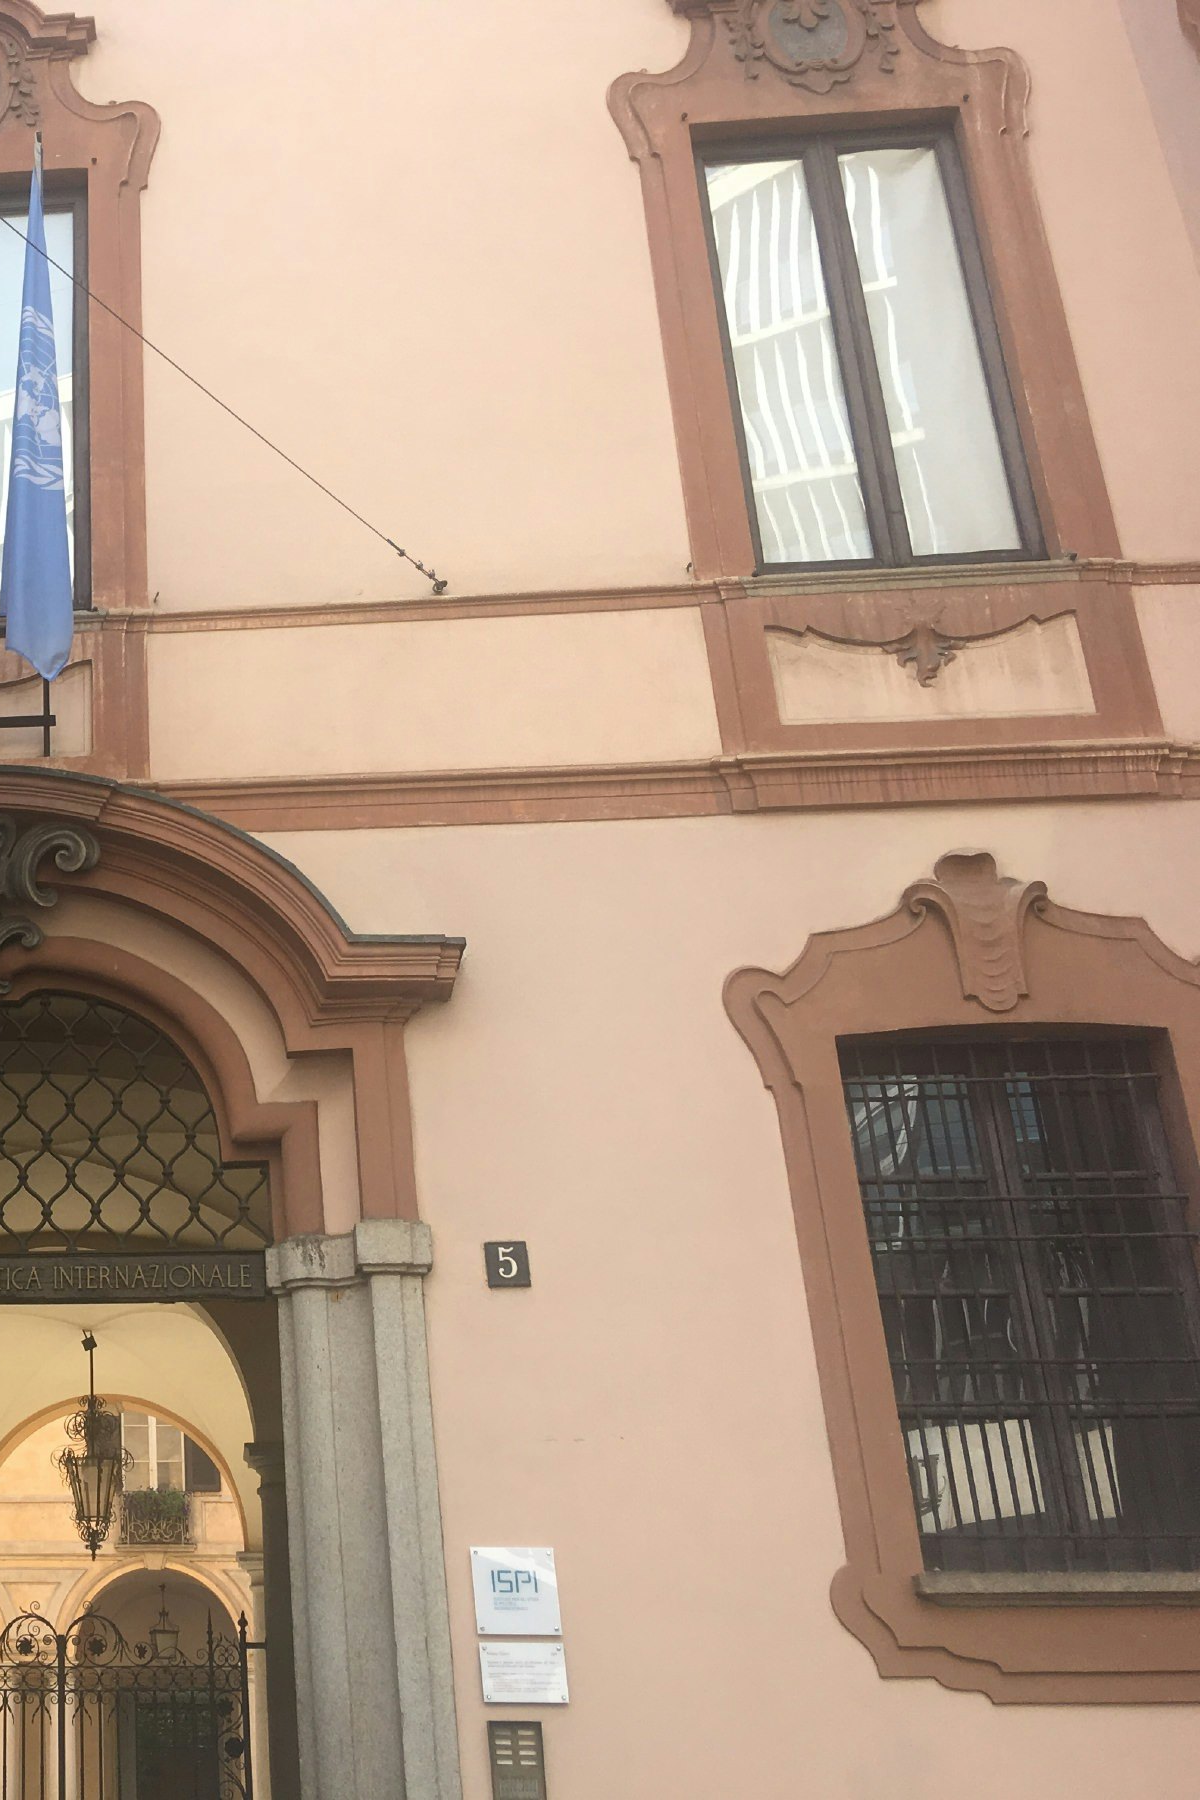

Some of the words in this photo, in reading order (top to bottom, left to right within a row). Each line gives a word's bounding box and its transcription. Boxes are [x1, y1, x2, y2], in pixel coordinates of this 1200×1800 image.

[498, 1246, 518, 1278] 5
[53, 1264, 252, 1289] INTERNAZIONALE
[491, 1570, 538, 1593] ISPI
